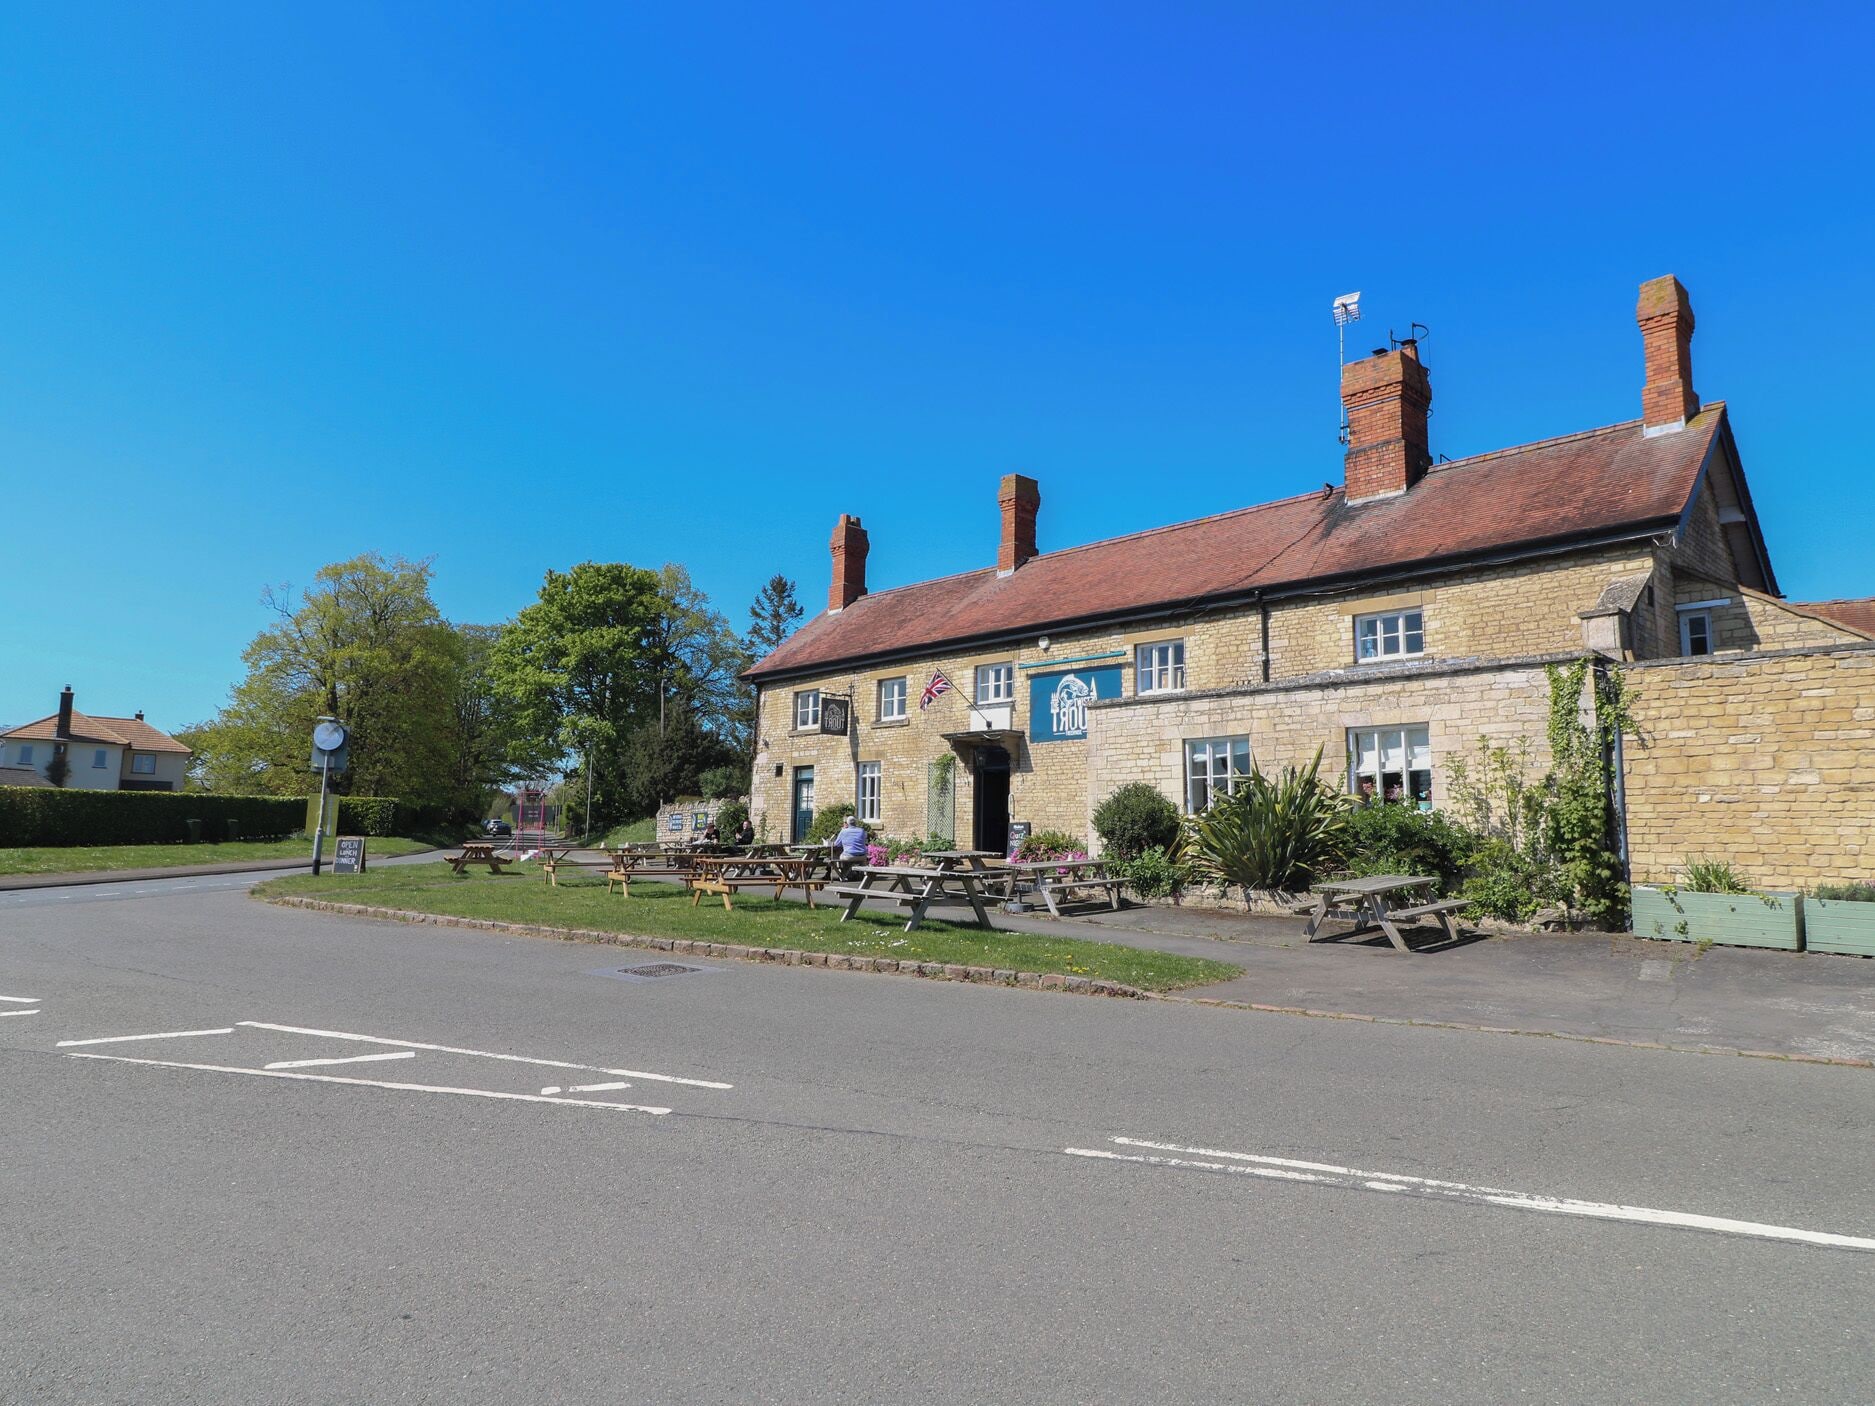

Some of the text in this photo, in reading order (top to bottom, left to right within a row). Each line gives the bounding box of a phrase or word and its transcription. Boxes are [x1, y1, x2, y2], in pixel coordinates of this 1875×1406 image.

[1050, 706, 1088, 733] TROU
[341, 841, 359, 849] OPEN
[339, 849, 358, 857] LUNCH
[335, 857, 356, 865] DINNER
